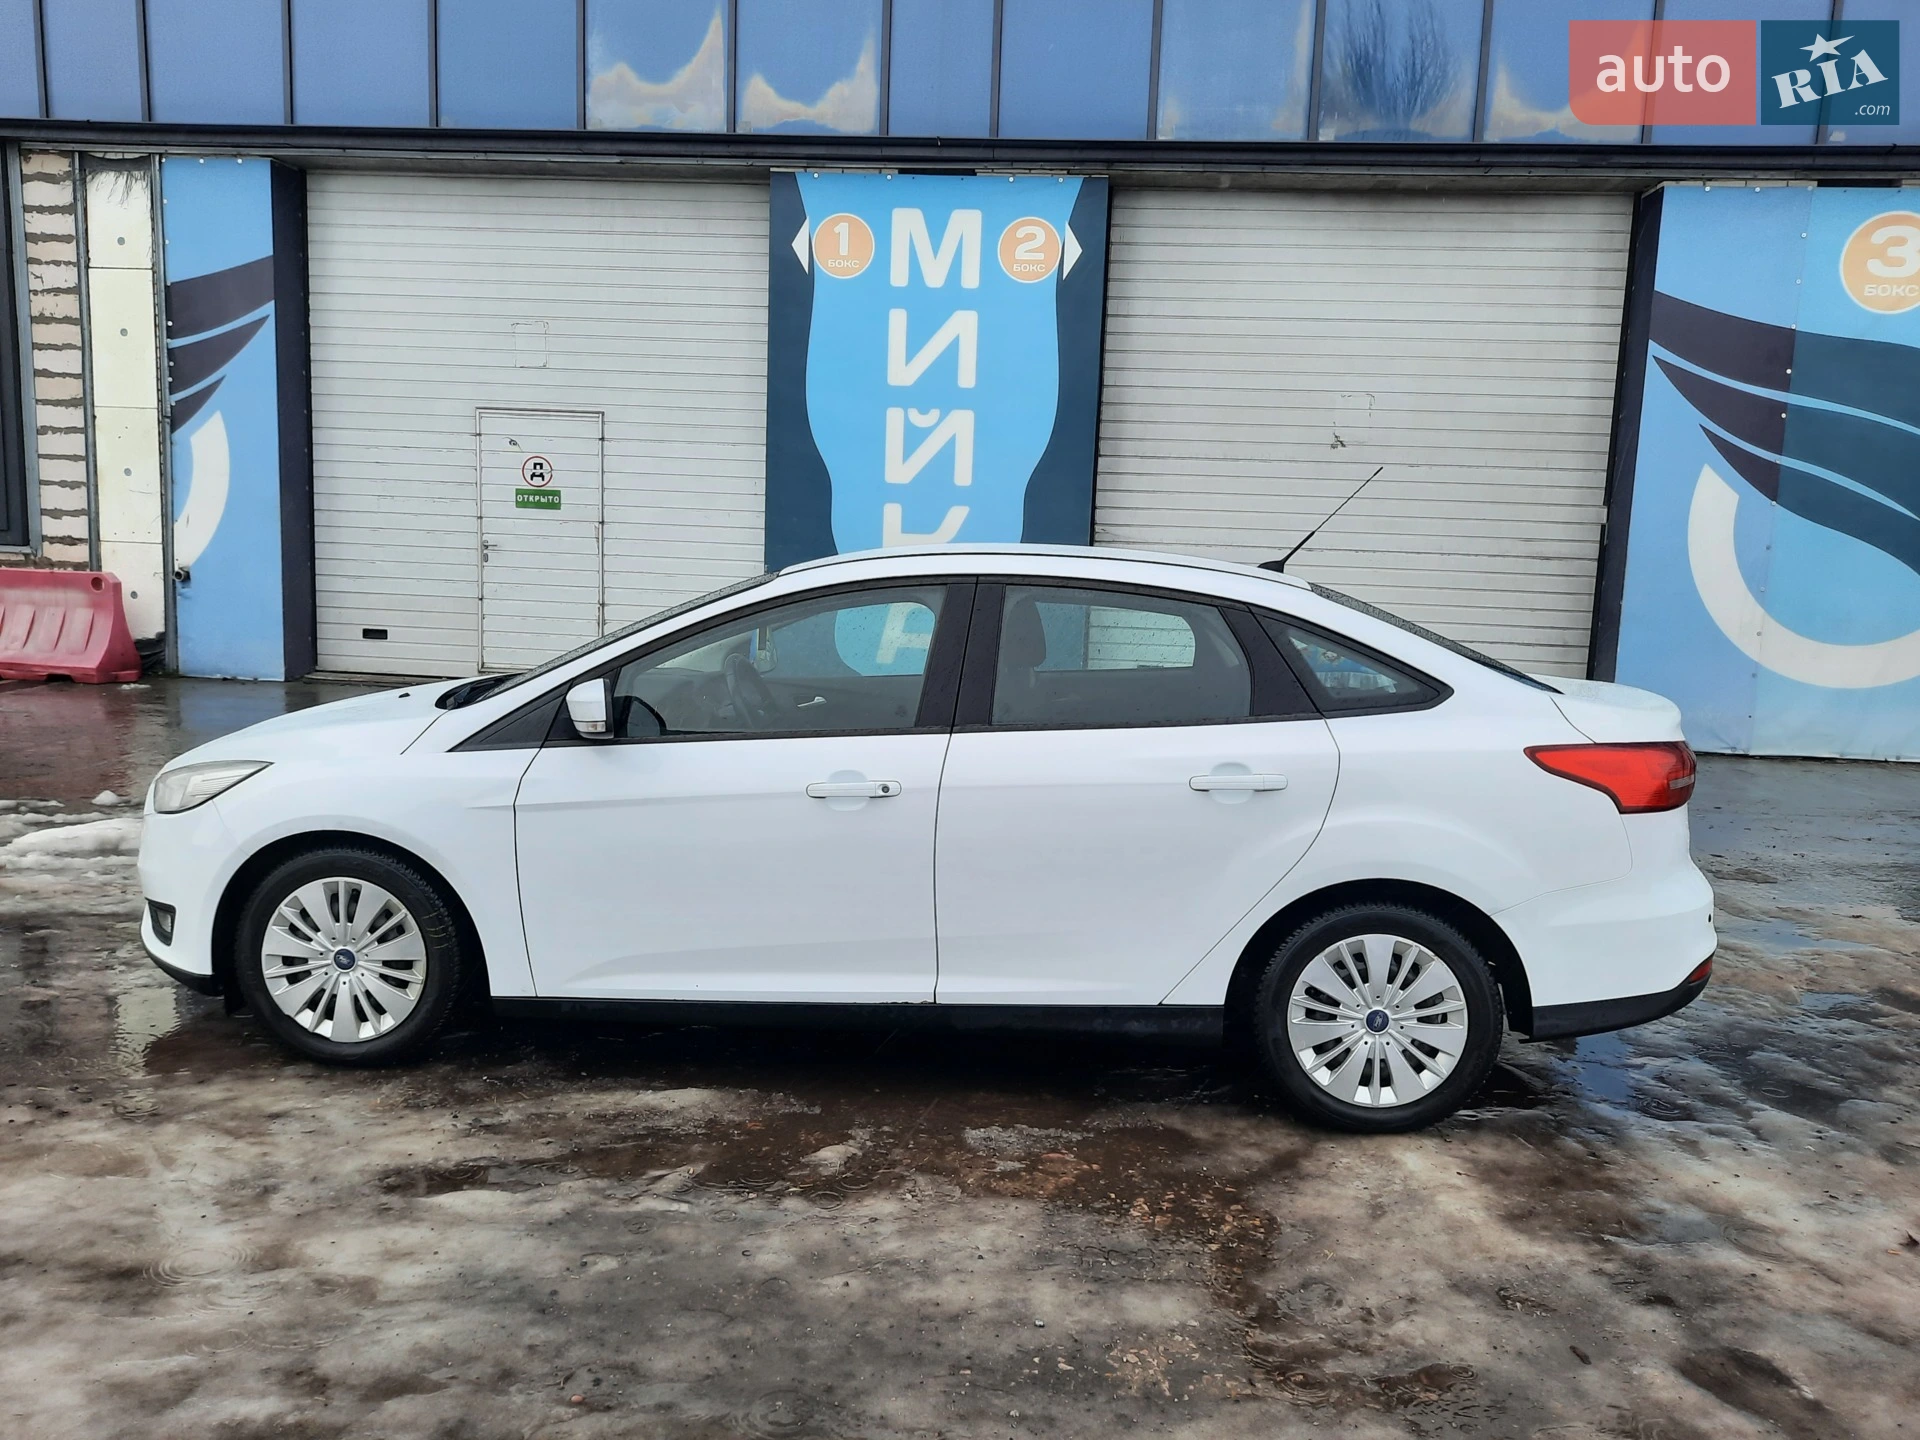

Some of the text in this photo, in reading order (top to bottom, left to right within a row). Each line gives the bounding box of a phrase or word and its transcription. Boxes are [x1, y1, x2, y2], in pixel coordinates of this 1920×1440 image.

[833, 222, 849, 256] 1
[1014, 225, 1046, 260] 2
[1866, 225, 1920, 278] 3
[827, 259, 860, 269] БОКС
[1012, 263, 1046, 273] БОКС
[1863, 283, 1919, 297] БОКС
[516, 494, 560, 503] ОТКРЫТО
